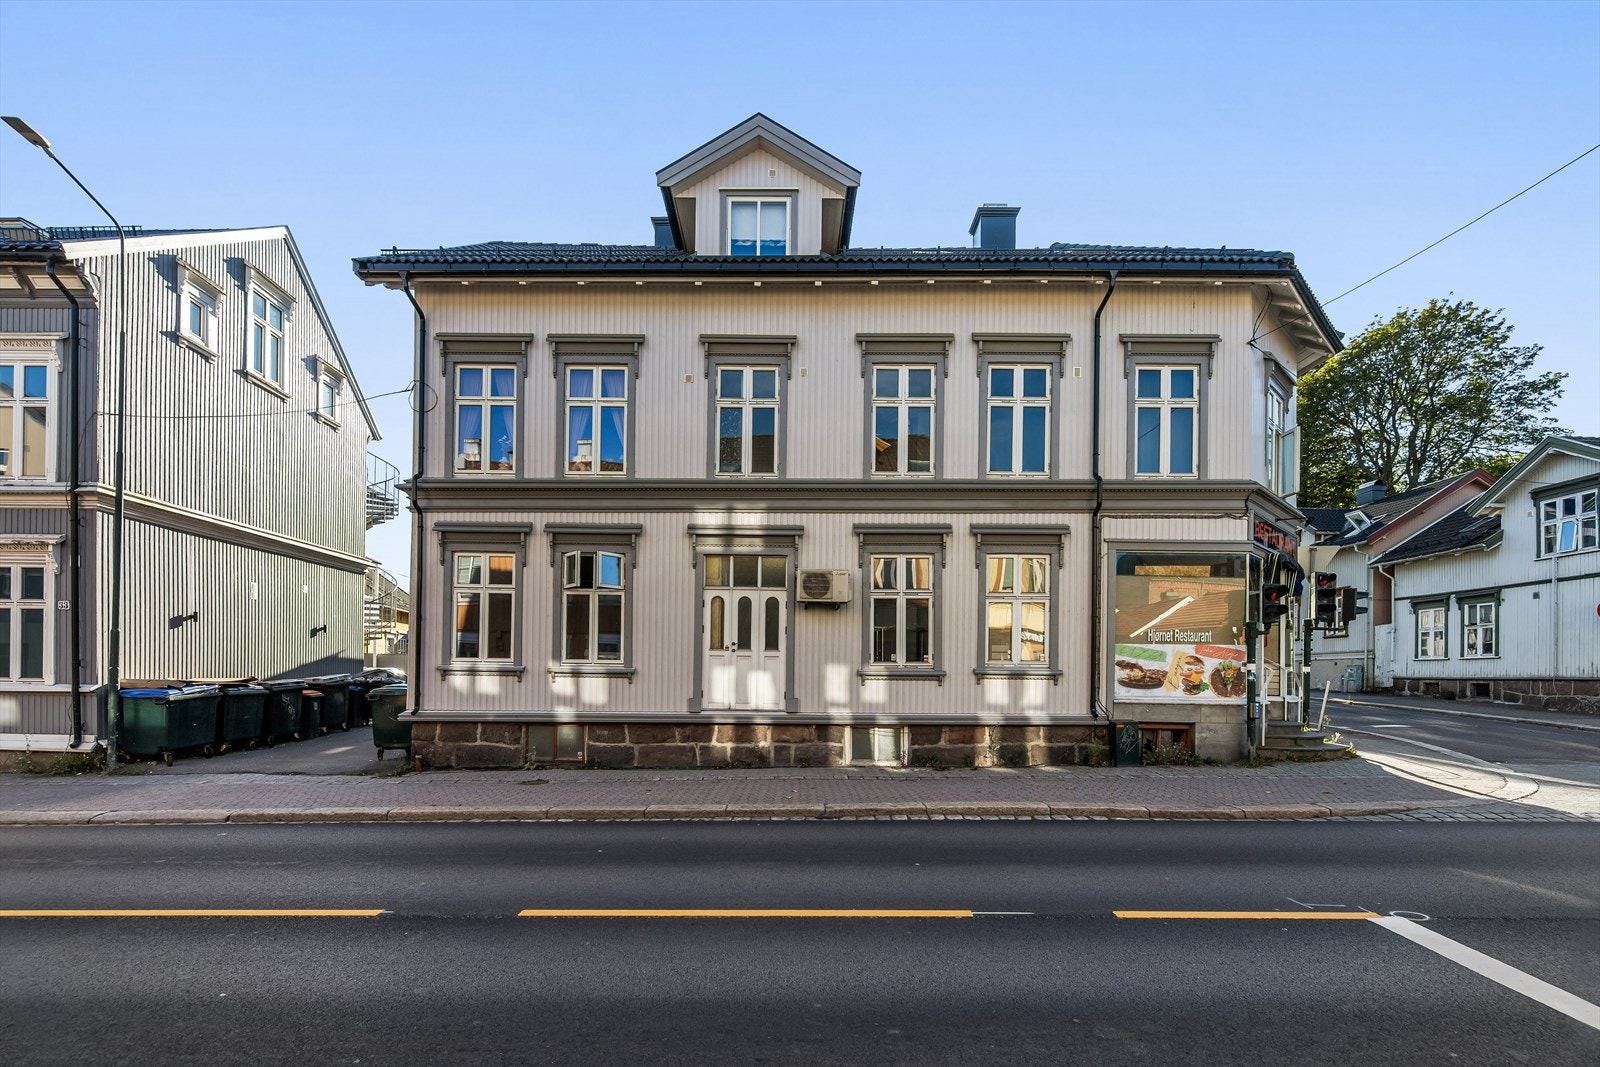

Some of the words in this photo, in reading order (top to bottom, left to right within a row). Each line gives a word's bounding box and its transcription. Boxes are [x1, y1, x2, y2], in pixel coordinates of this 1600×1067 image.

[59, 601, 69, 609] 33
[1147, 628, 1173, 644] Hjørnet
[1174, 629, 1212, 642] Restaurant
